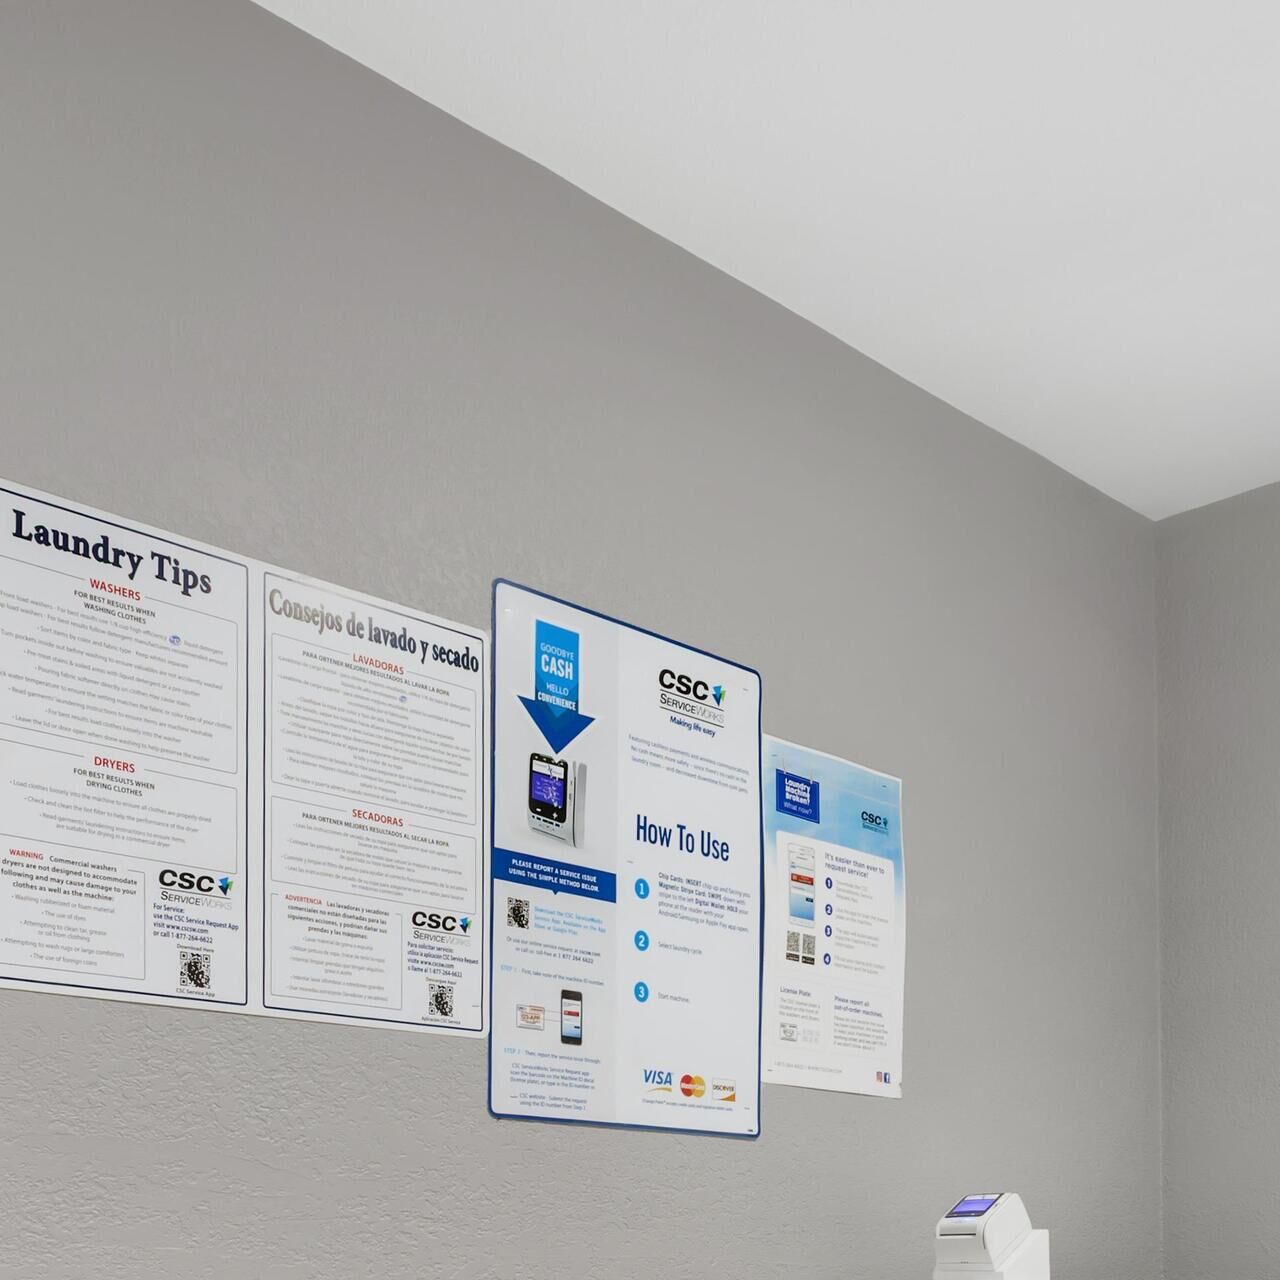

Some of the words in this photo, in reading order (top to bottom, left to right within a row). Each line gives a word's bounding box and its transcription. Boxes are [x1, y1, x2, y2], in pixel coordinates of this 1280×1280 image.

[13, 509, 143, 580] Laundry
[151, 551, 212, 597] Tips
[90, 578, 141, 602] WASHERS
[74, 589, 88, 600] FOR
[89, 593, 105, 604] BEST
[107, 598, 134, 612] RESULTS
[136, 606, 155, 618] WHEN
[84, 601, 115, 616] WASHING
[117, 610, 146, 625] CLOTHES
[269, 589, 342, 635] Consejos
[346, 612, 364, 639] de
[368, 617, 416, 654] lavado
[420, 640, 428, 664] y
[432, 644, 479, 673] secado
[539, 640, 574, 661] GOODBYE
[302, 651, 317, 661] PARA
[318, 655, 343, 668] OBTENER
[345, 662, 369, 674] MEJORES
[370, 669, 403, 684] RESULTADOS
[436, 687, 449, 696] ROPA
[353, 653, 404, 676] LAVADORAS
[540, 652, 573, 681] CASH
[545, 681, 569, 697] HELLO
[659, 666, 708, 703] CSC
[537, 691, 576, 711] CONVENIENCE
[670, 715, 691, 730] Making
[693, 722, 702, 733] life
[703, 725, 715, 738] easy
[94, 756, 134, 773] DRYERS
[73, 768, 87, 777] FOR
[89, 771, 104, 780] BEST
[106, 774, 133, 786] RESULTS
[135, 780, 154, 790] WHEN
[86, 780, 112, 791] DRYING
[113, 785, 142, 797] CLOTHES
[352, 808, 403, 827] SECADORAS
[861, 811, 882, 826] CSC
[302, 813, 317, 821] PARA
[318, 816, 343, 827] OBTENER
[344, 821, 368, 832] MEJORES
[370, 827, 402, 838] RESULTADOS
[411, 834, 427, 843] SECAR
[436, 839, 448, 847] ROPA
[636, 814, 671, 847] How
[677, 824, 694, 853] To
[701, 831, 729, 861] Use
[9, 848, 43, 861] WARNING
[49, 855, 89, 868] Commercial
[91, 862, 116, 873] washers
[512, 857, 532, 870] PLEASE
[533, 862, 552, 874] REPORT
[559, 867, 580, 880] SERVICE
[582, 872, 597, 883] ISSUE
[0, 868, 33, 881] following
[35, 873, 48, 883] and
[50, 876, 63, 885] may
[65, 879, 83, 889] cause
[86, 881, 112, 893] damage
[113, 886, 120, 894] to
[121, 887, 136, 896] your
[1, 858, 24, 868] dryers
[37, 864, 49, 872] not
[51, 866, 81, 877] designed
[83, 871, 90, 879] to
[92, 872, 137, 886] accommodate
[158, 868, 214, 894] CSC
[508, 866, 525, 878] USING
[527, 870, 537, 880] THE
[539, 872, 558, 884] SIMPLE
[12, 880, 38, 891] clothes
[39, 884, 46, 892] as
[48, 885, 61, 894] well
[71, 889, 81, 897] the
[153, 902, 162, 911] For
[284, 894, 322, 906] ADVERTENCIA
[153, 911, 161, 920] use
[163, 913, 173, 922] the
[174, 914, 184, 923] CSC
[186, 916, 204, 926] Service
[206, 919, 227, 929] Request
[228, 922, 238, 931] App
[153, 920, 164, 928] visit
[166, 922, 208, 934] www.cscsw.com
[411, 910, 457, 932] CSC
[159, 930, 169, 938] call
[643, 1069, 672, 1086] VISA
